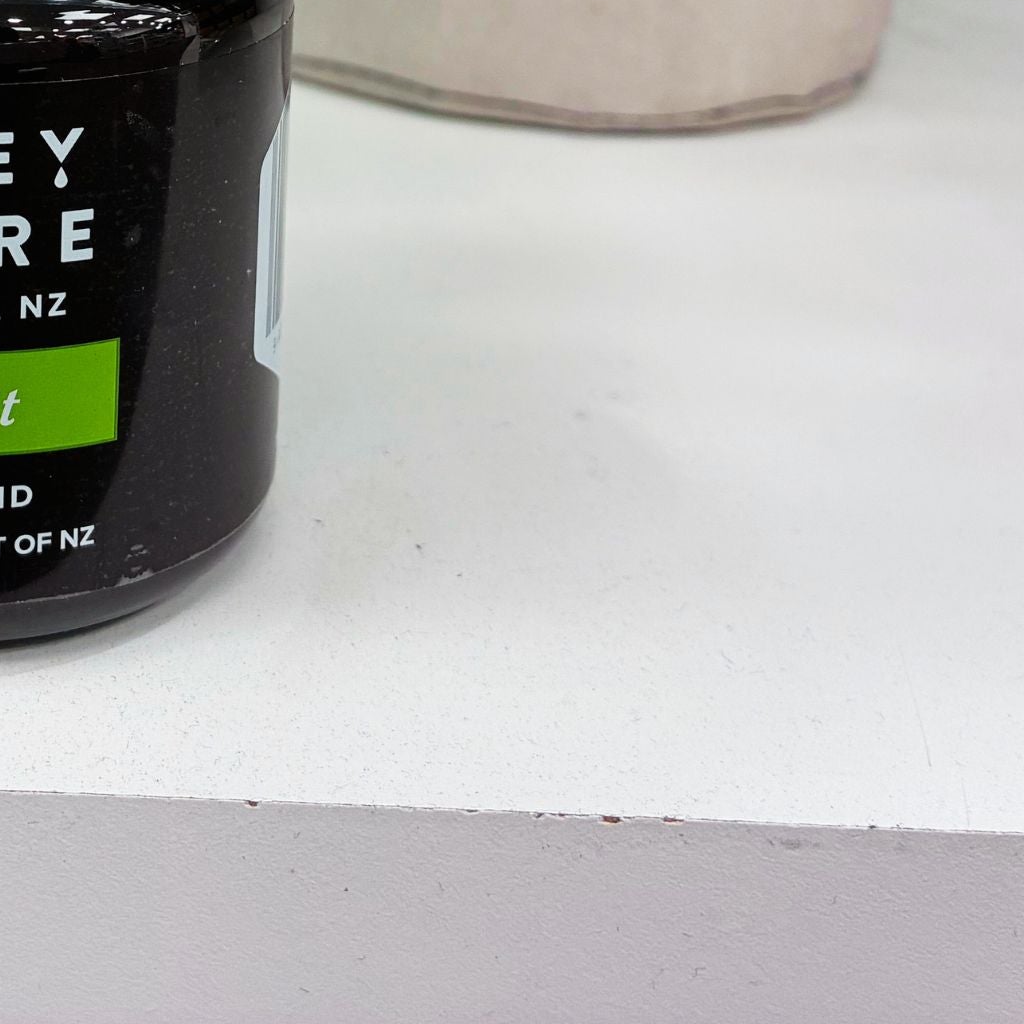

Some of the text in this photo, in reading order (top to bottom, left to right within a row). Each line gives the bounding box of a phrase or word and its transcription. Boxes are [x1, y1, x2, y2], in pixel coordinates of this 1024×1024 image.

[20, 291, 67, 320] NZ
[13, 531, 53, 556] OF
[60, 524, 95, 550] NZ
